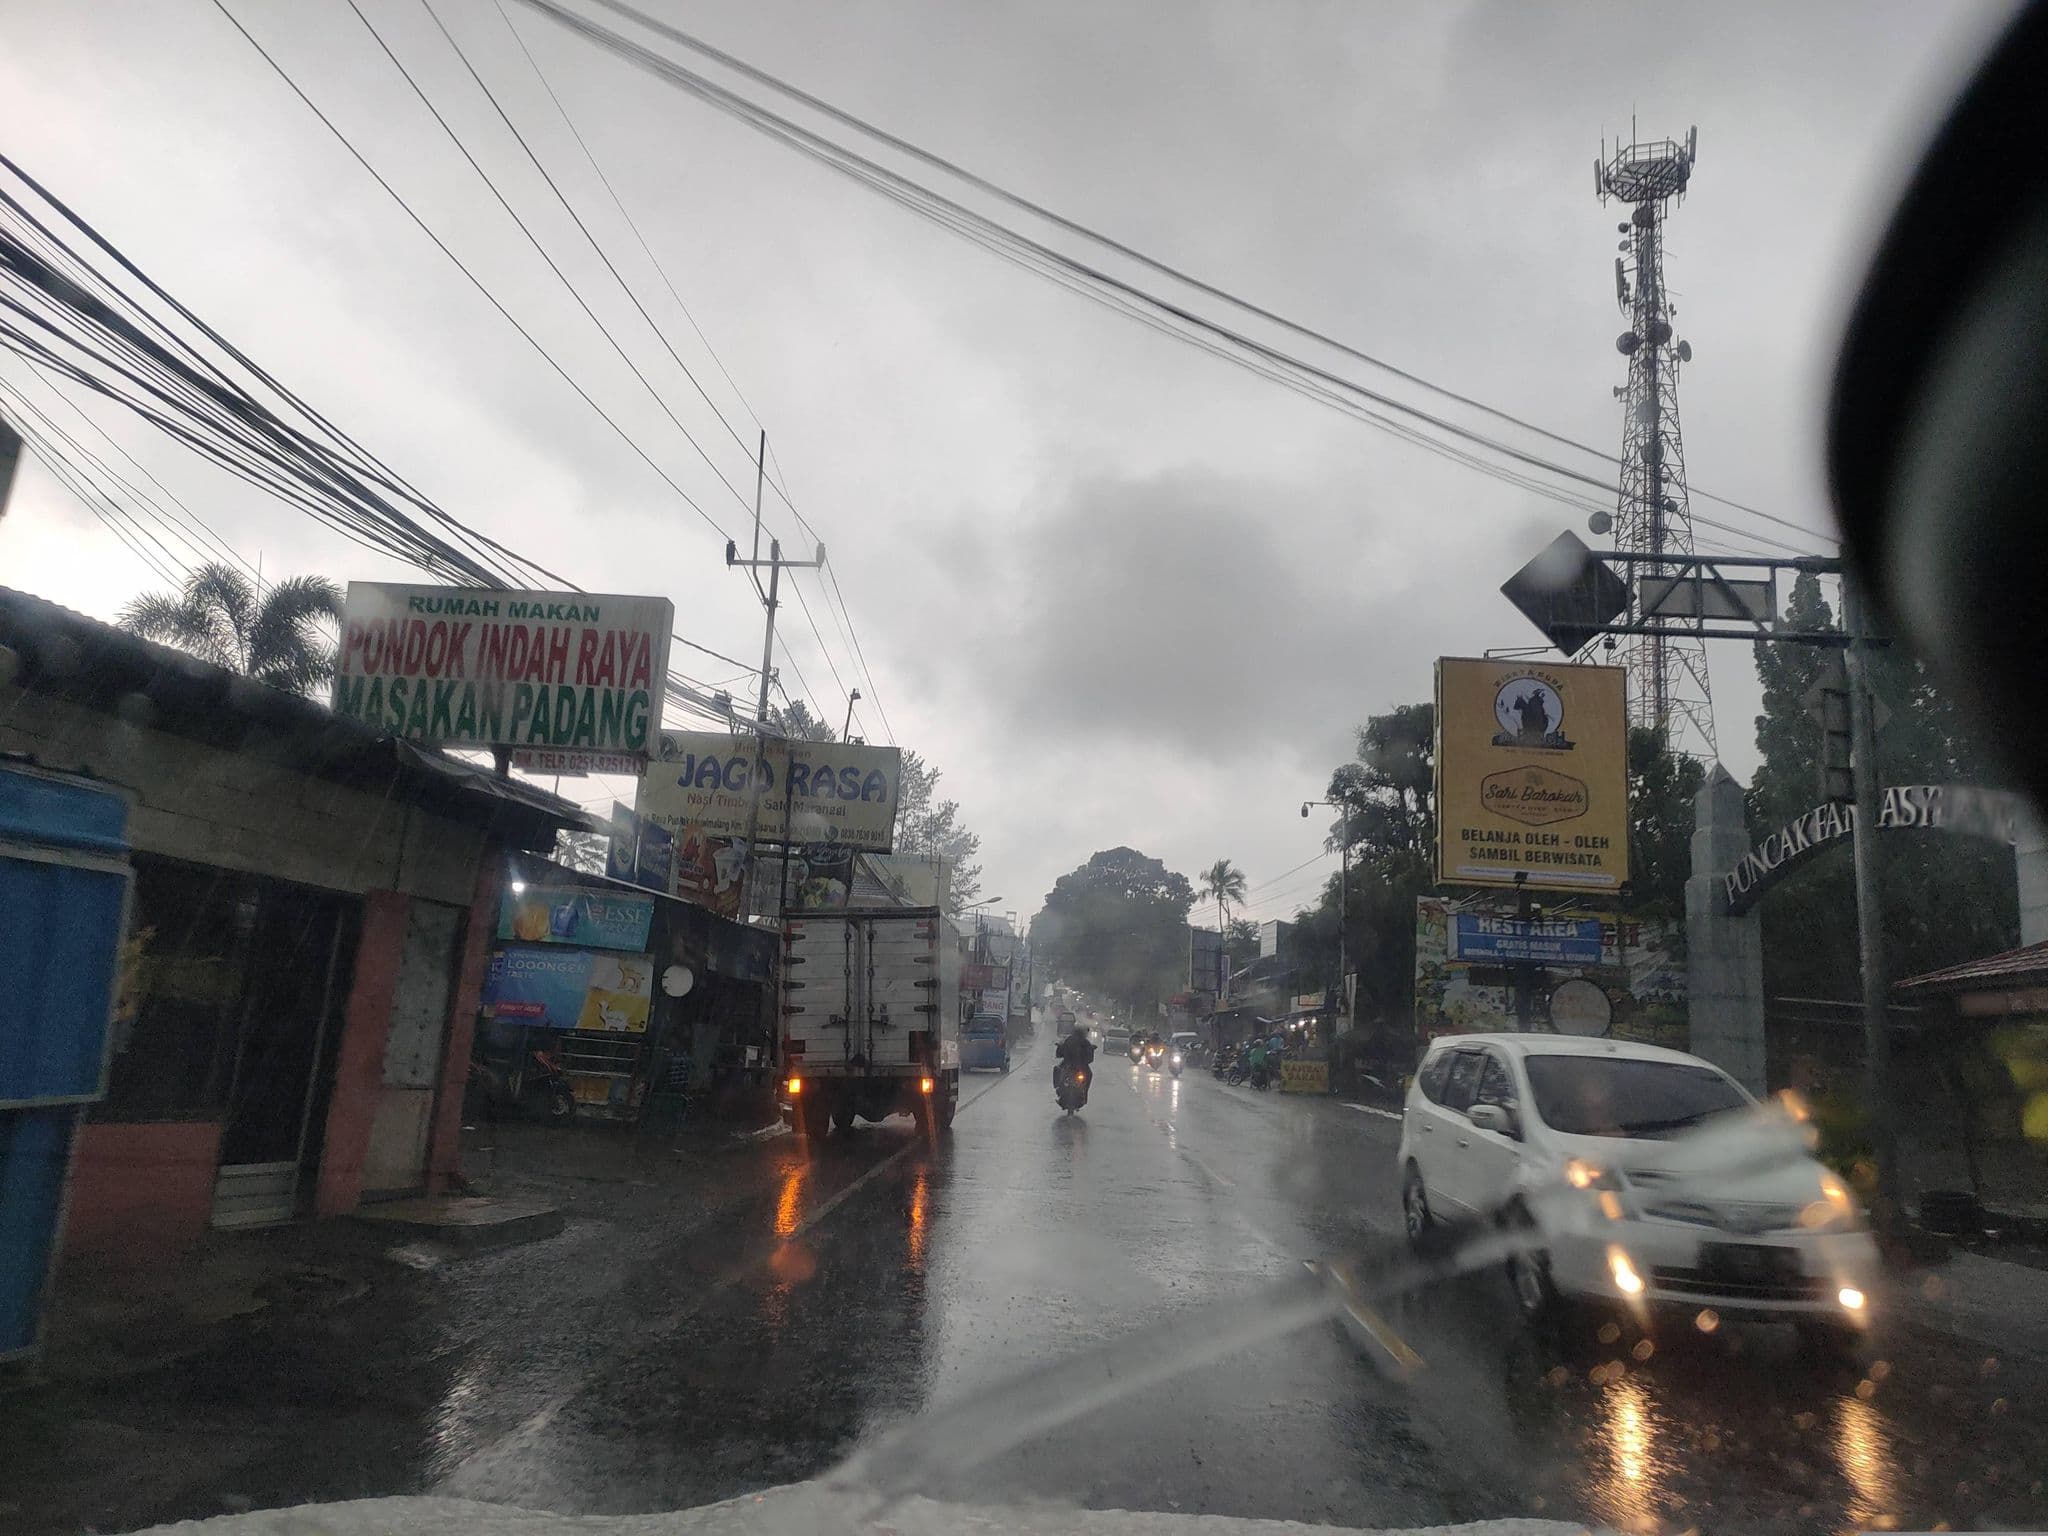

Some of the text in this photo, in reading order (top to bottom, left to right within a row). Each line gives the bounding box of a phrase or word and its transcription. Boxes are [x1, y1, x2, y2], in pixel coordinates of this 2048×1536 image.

[408, 596, 601, 623] RUMAH MAKAN
[343, 618, 651, 690] PONDOK INDAH RAYA
[337, 676, 650, 751] MASAKAN PADANG
[678, 753, 888, 803] JAGO RASA
[1461, 828, 1521, 845] BELANJA
[1524, 832, 1559, 847] OLEH
[1574, 835, 1610, 850] OLEH
[1469, 846, 1602, 867] SAMBIL BERWISATA
[1724, 812, 1815, 906] PUNCAK
[1478, 916, 1526, 936] REST
[1529, 920, 1579, 938] AREA
